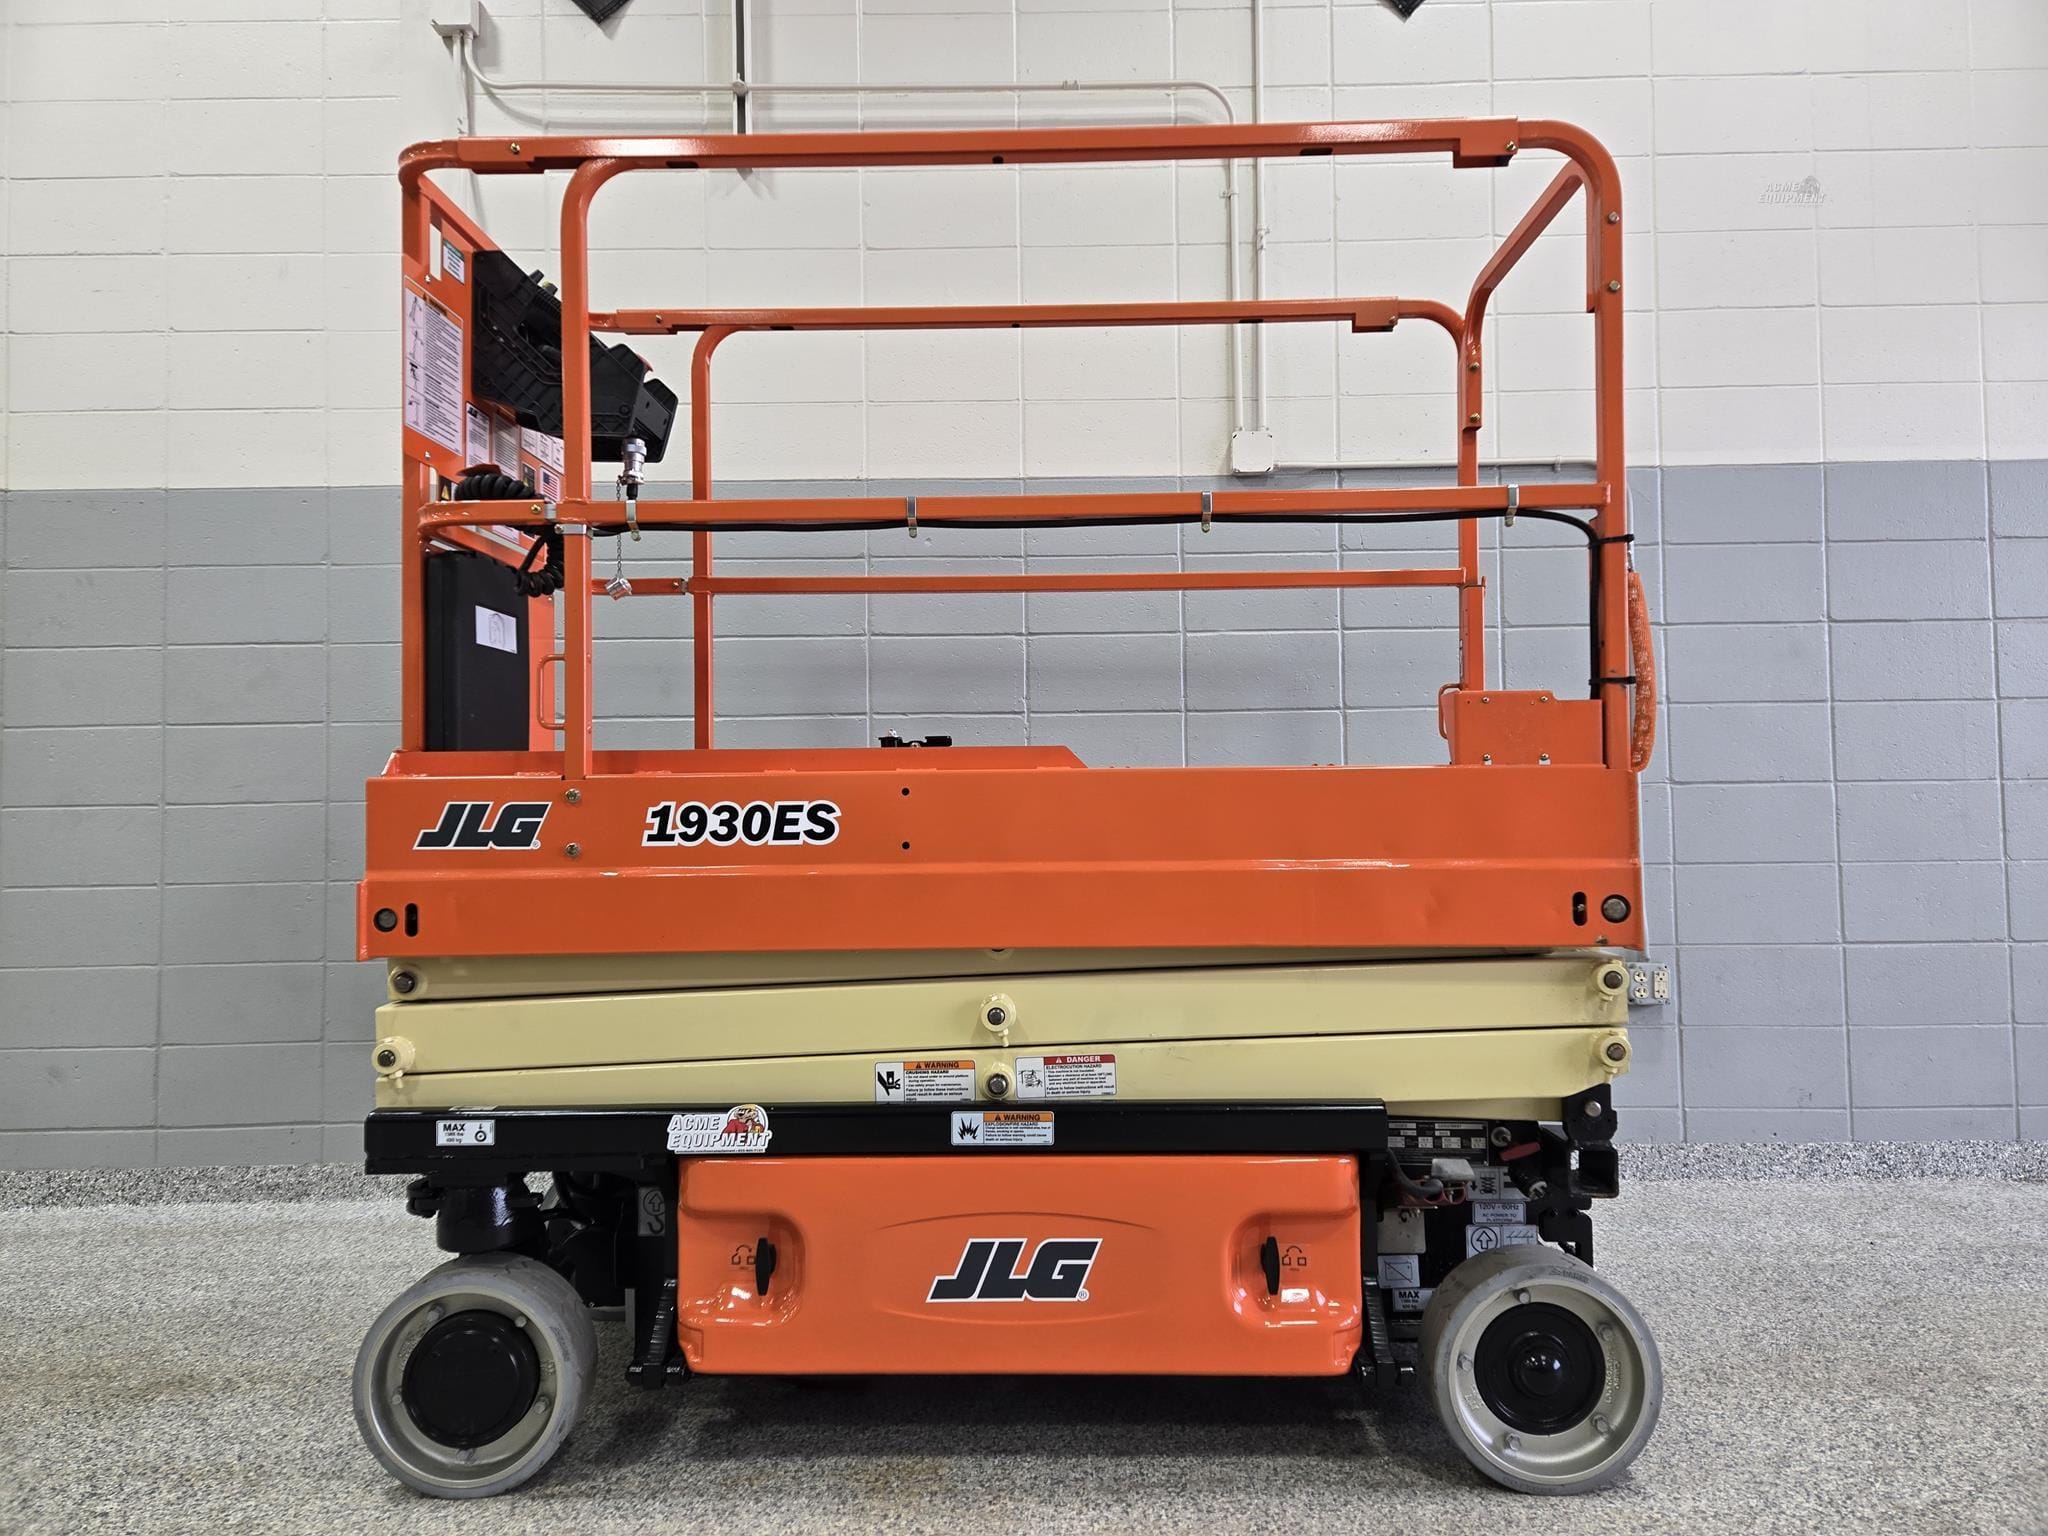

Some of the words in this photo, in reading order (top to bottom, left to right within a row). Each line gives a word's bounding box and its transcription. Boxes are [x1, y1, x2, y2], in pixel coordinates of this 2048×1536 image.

[413, 802, 552, 849] JLG
[644, 803, 840, 845] 1930ES
[443, 1124, 465, 1132] MAX
[670, 1115, 720, 1132] ACME
[670, 1132, 769, 1149] EQUIPMENT
[927, 1239, 1102, 1301] JLG
